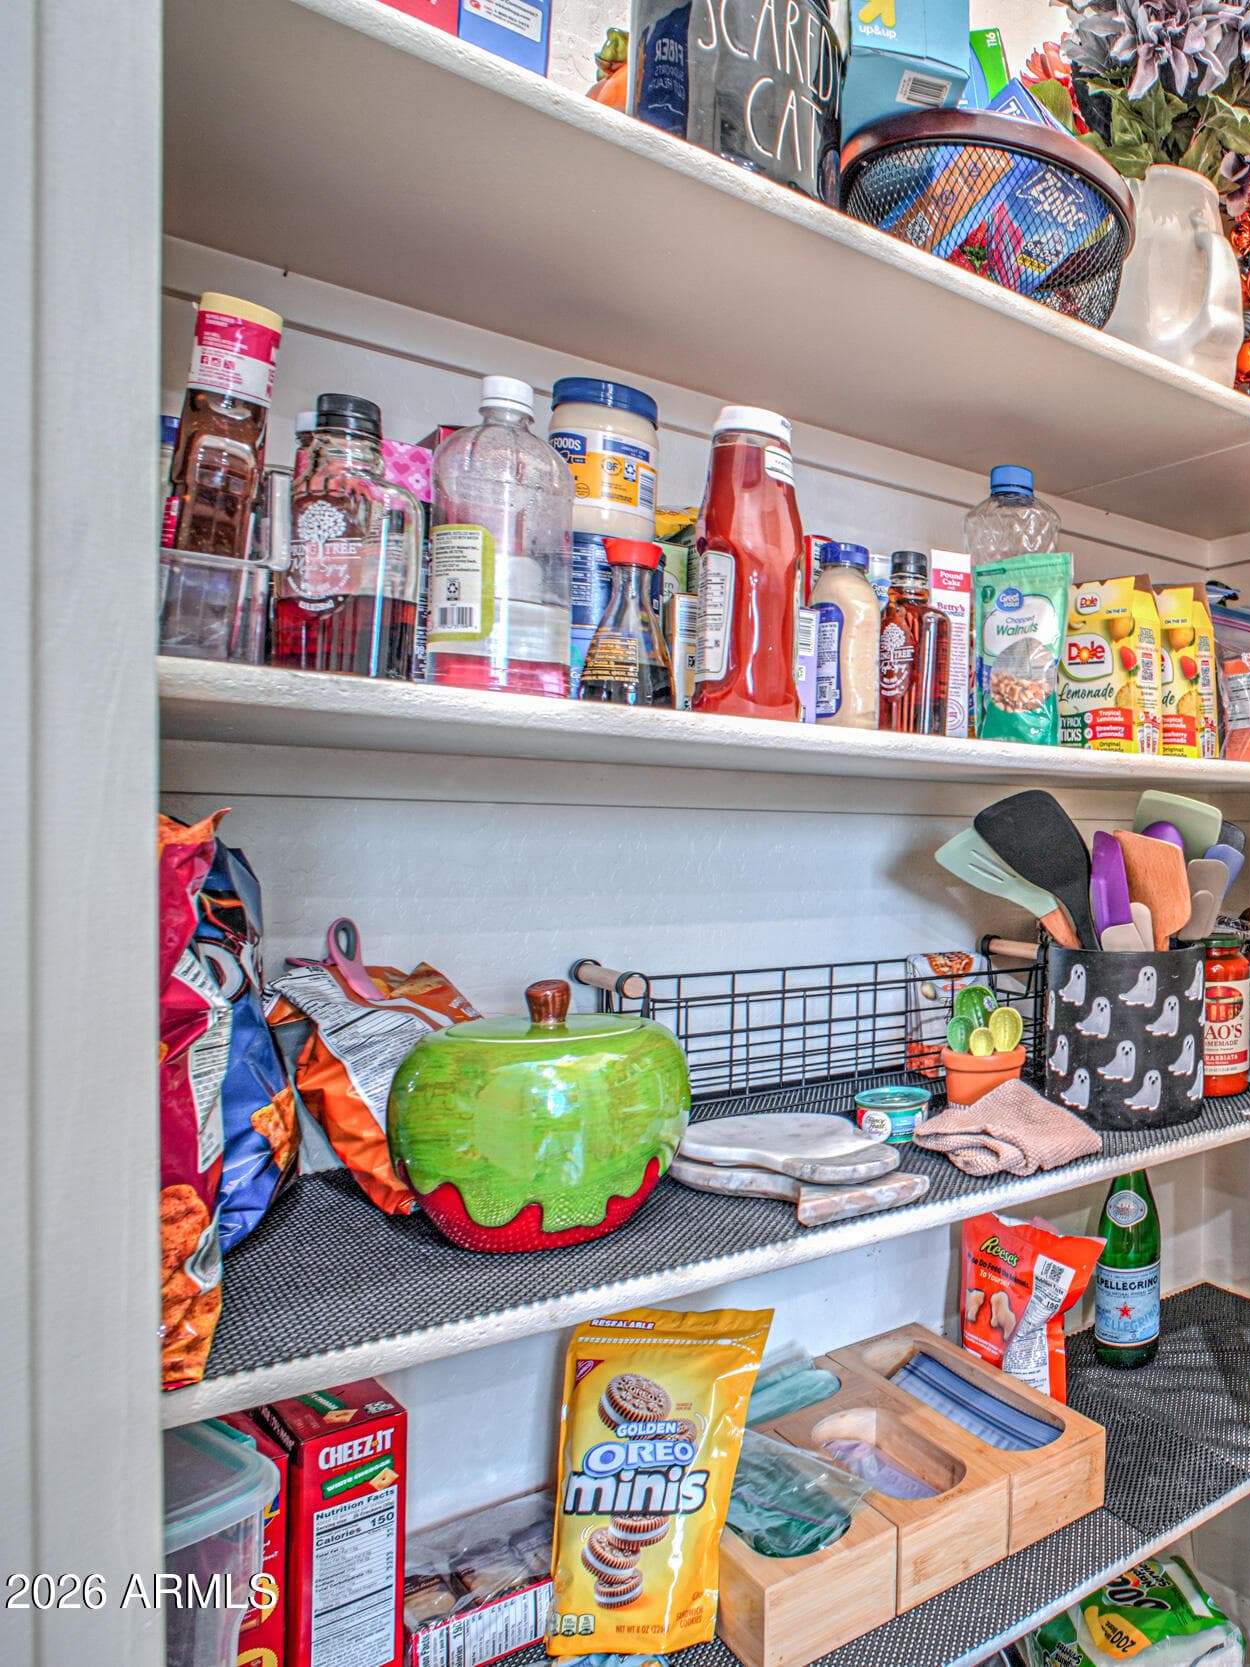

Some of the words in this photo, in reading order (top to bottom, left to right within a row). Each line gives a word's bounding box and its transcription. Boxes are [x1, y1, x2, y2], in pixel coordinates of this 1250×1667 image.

[858, 24, 898, 39] up&up
[746, 77, 822, 180] CAT
[939, 571, 964, 580] Pound
[941, 578, 961, 587] Cake
[1080, 596, 1098, 605] Dole
[996, 622, 1039, 637] Walnuts
[1068, 639, 1106, 662] Dole
[1058, 683, 1115, 703] Lemonade
[1204, 1023, 1243, 1040] AO'S
[980, 1236, 1019, 1267] Reese's
[591, 1318, 655, 1330] RESEALABLE
[616, 1421, 678, 1437] GOLDEN
[585, 1441, 694, 1477] OREO
[564, 1465, 710, 1514] minis
[315, 1500, 364, 1521] Nutrition
[367, 1489, 395, 1503] Facts
[315, 1525, 362, 1548] Calories
[370, 1511, 395, 1528] 150
[1111, 1631, 1136, 1653] 200
